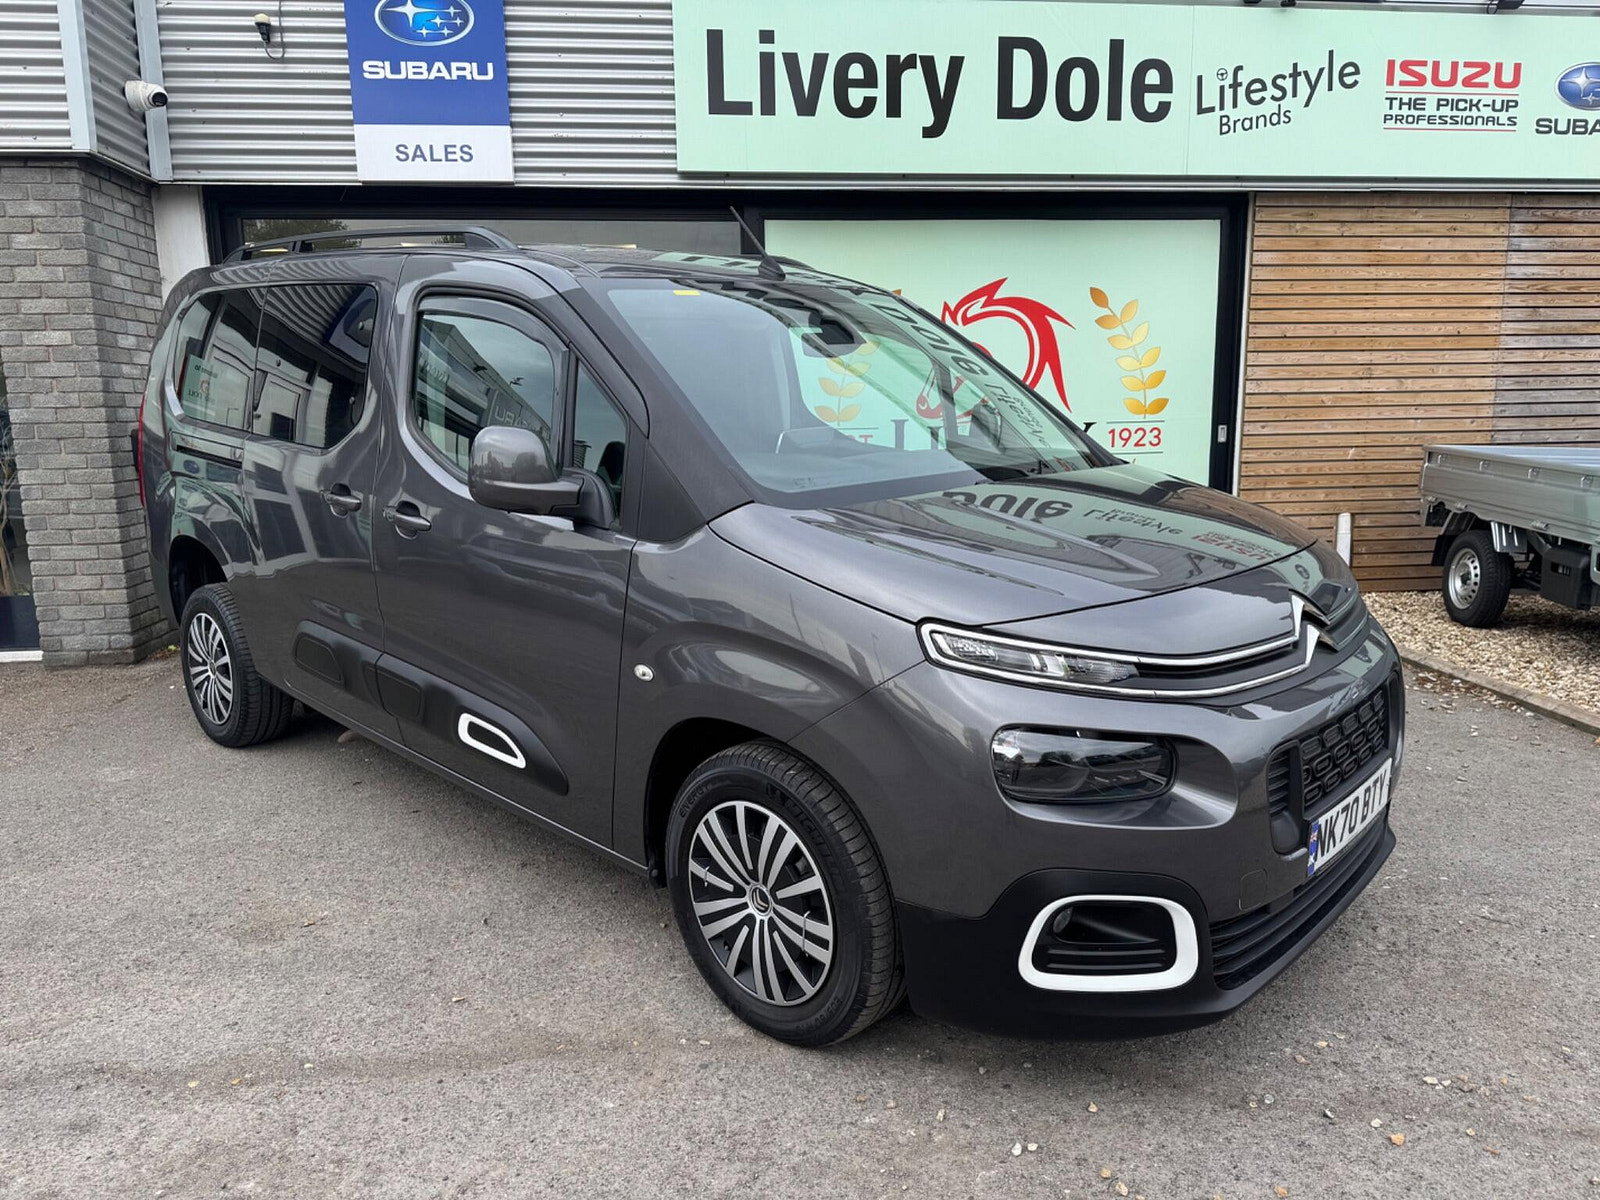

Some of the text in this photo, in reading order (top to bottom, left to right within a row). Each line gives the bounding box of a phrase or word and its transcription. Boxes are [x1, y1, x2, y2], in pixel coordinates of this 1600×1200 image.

[362, 61, 494, 81] SUBARU
[1196, 49, 1361, 115] Lifestyle
[1386, 59, 1522, 89] ISUZU
[707, 29, 1174, 139] Livery Dole
[1385, 97, 1519, 112] THE PICK-UP
[1219, 103, 1292, 136] Brands
[1383, 113, 1518, 127] PROFESSIONALS
[395, 144, 474, 163] SALES
[1108, 427, 1162, 448] 1923
[1314, 769, 1387, 862] NK70 BTY
